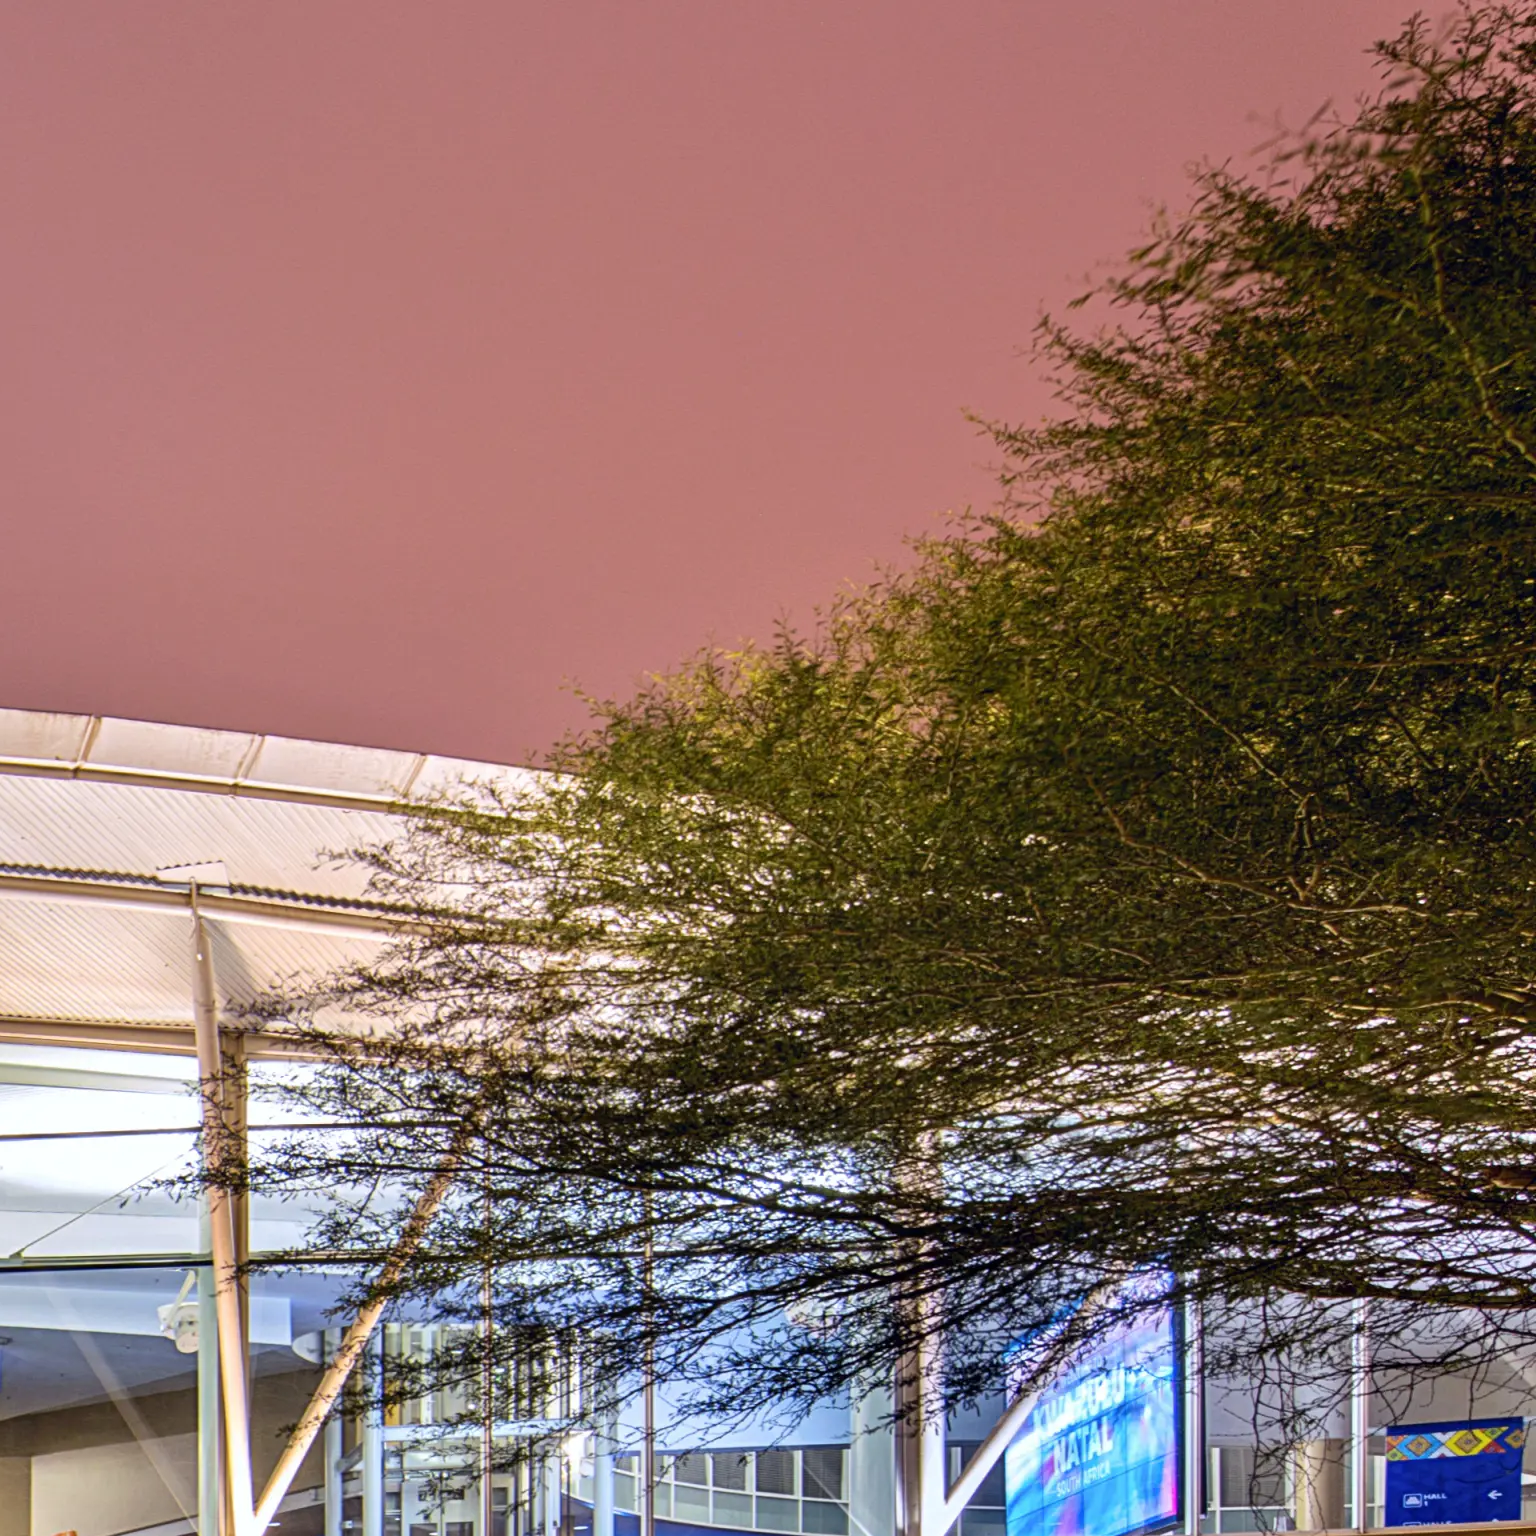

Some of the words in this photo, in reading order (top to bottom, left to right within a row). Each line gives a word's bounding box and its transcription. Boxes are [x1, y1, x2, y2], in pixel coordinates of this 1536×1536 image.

[1053, 1416, 1114, 1473] NATAL
[1056, 1473, 1081, 1497] SOUTH
[1084, 1460, 1111, 1484] AFRICA
[1423, 1492, 1447, 1500] HALL
